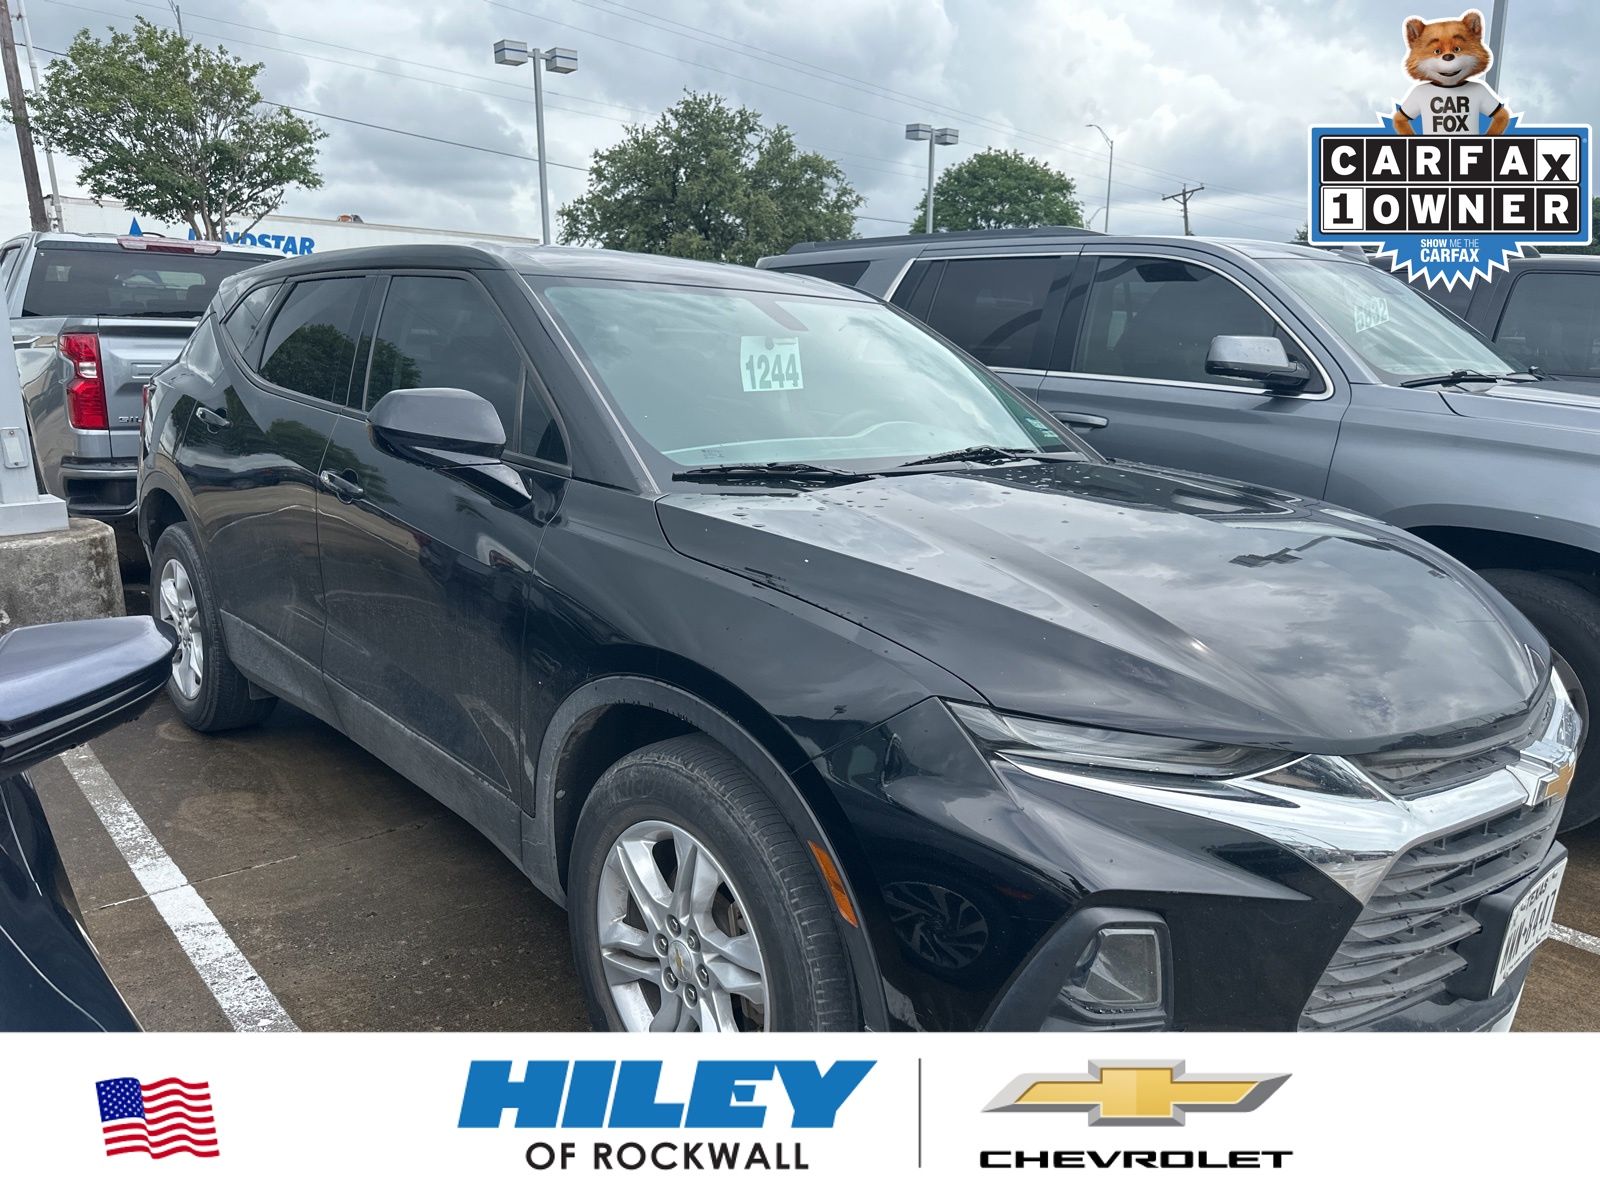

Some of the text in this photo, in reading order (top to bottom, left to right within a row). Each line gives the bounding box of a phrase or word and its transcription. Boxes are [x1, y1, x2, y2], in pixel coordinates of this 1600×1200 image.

[188, 228, 314, 255] NDSTAR
[746, 354, 799, 389] 1244
[1527, 879, 1549, 907] TEXAS
